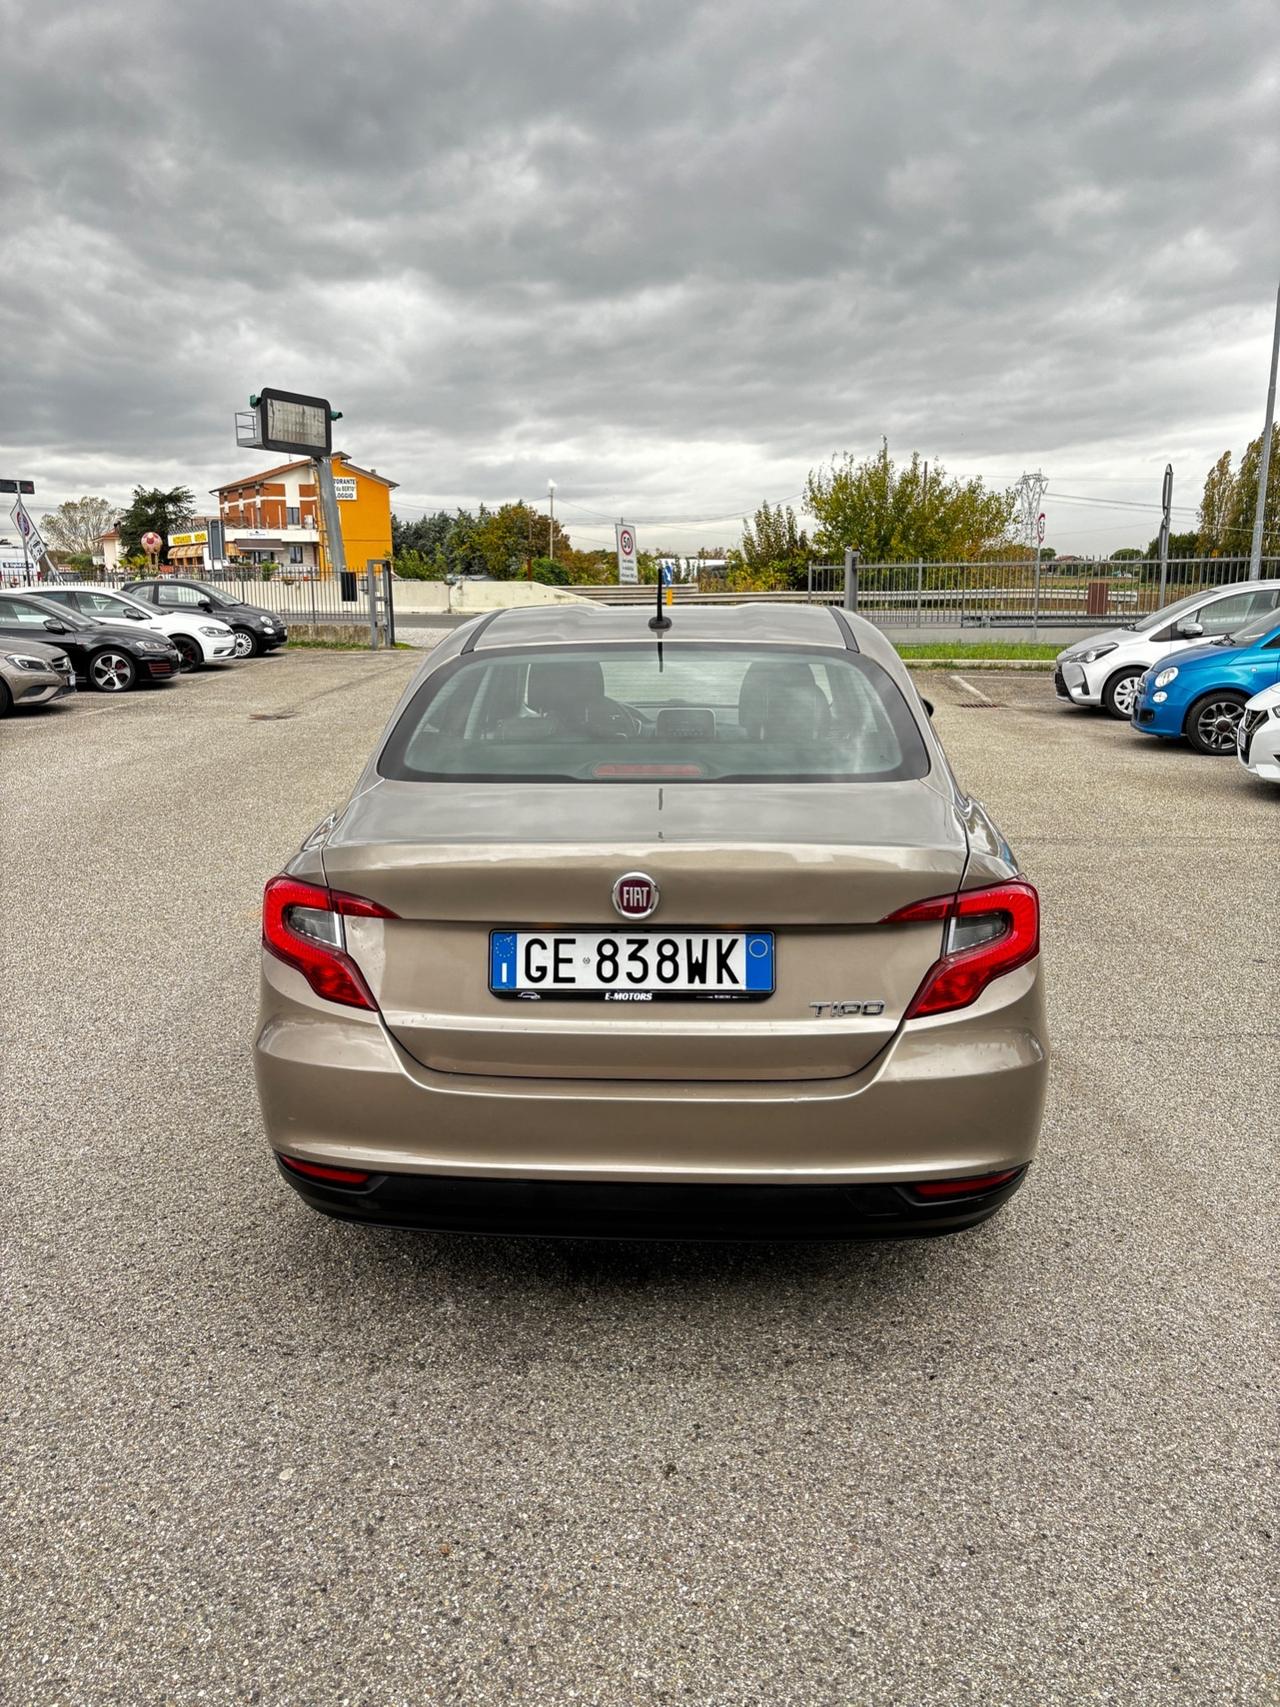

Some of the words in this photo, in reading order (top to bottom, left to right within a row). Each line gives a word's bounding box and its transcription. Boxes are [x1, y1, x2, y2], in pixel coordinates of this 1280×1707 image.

[623, 536, 631, 549] 50
[623, 886, 649, 907] FIAT
[524, 937, 577, 984] GE
[596, 938, 740, 985] 838WK
[604, 991, 653, 1001] E-MOTORS
[809, 1000, 885, 1018] TIPO
